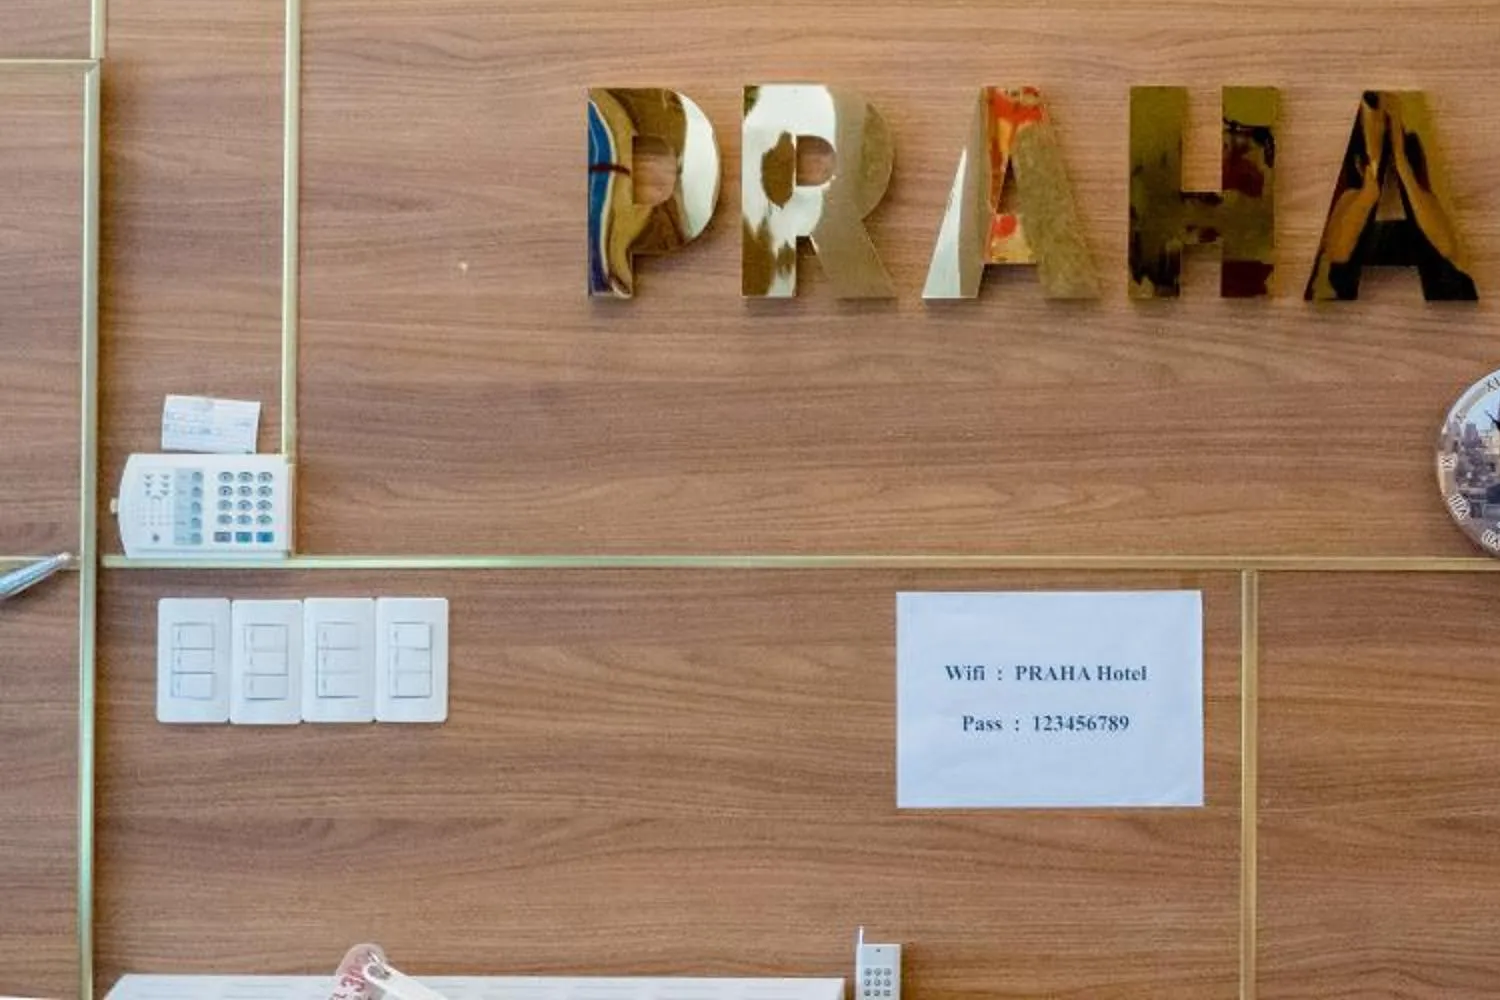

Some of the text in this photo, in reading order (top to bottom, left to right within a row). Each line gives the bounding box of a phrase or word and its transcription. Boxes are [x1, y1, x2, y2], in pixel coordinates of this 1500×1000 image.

[587, 84, 1479, 303] PRAHA
[945, 665, 985, 681] Wifi
[1015, 665, 1091, 681] PRAHA
[1097, 665, 1147, 681] Hotel
[962, 715, 1003, 732] Pass
[1033, 715, 1130, 732] 123456789
